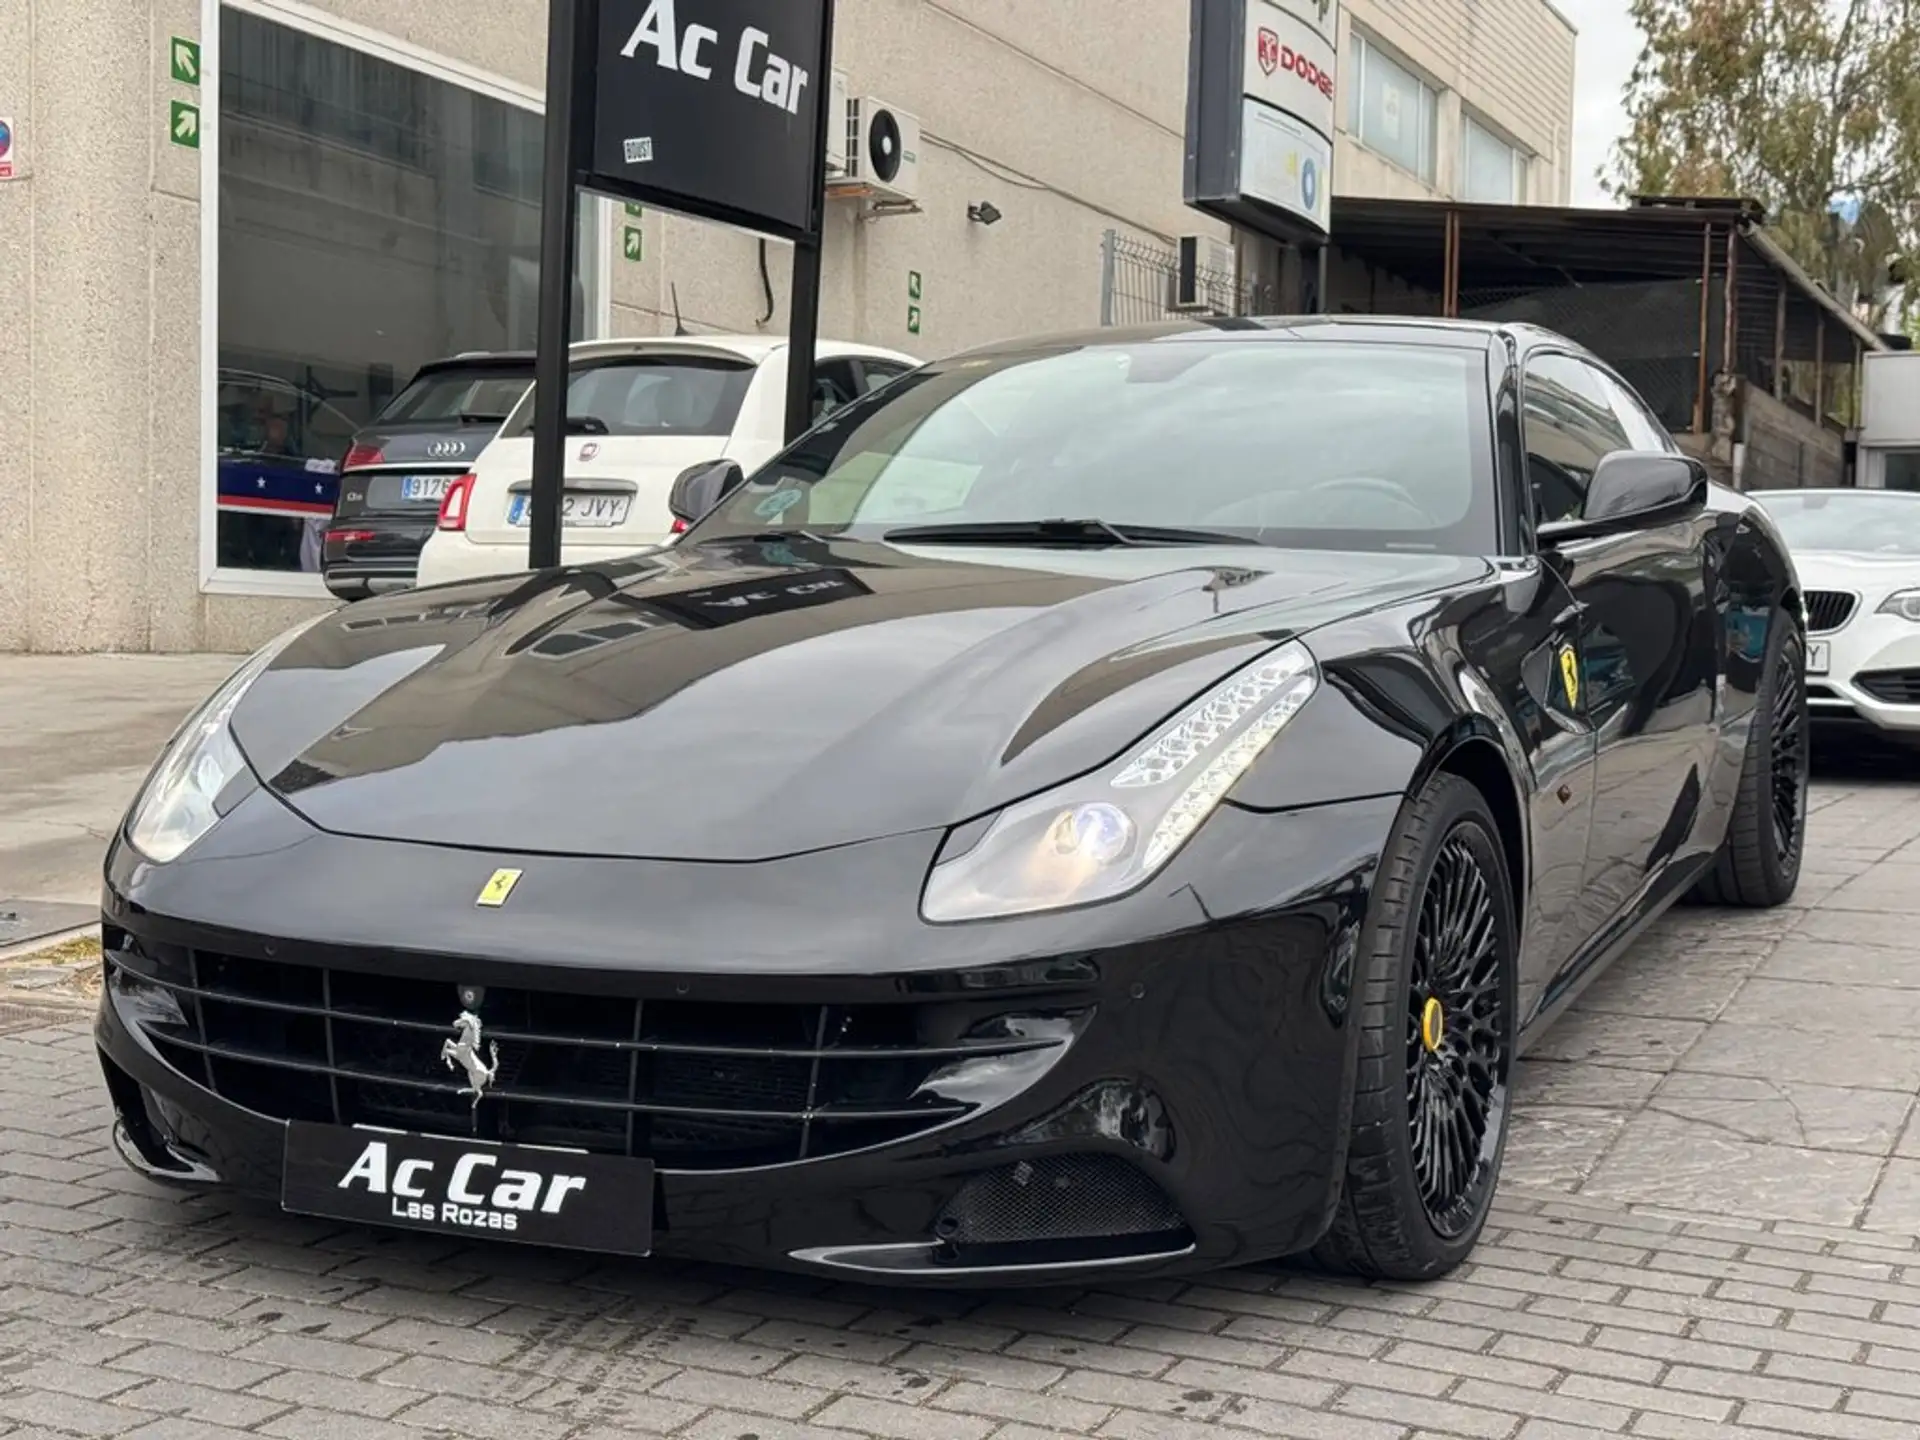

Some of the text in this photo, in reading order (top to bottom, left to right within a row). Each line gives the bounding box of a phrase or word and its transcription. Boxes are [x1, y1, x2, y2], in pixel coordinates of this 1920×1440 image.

[620, 0, 809, 115] Ac Car
[1280, 44, 1333, 102] DODGE
[581, 496, 620, 517] JVY
[338, 1141, 587, 1214] Ac Car
[391, 1196, 518, 1230] Las Rozas
